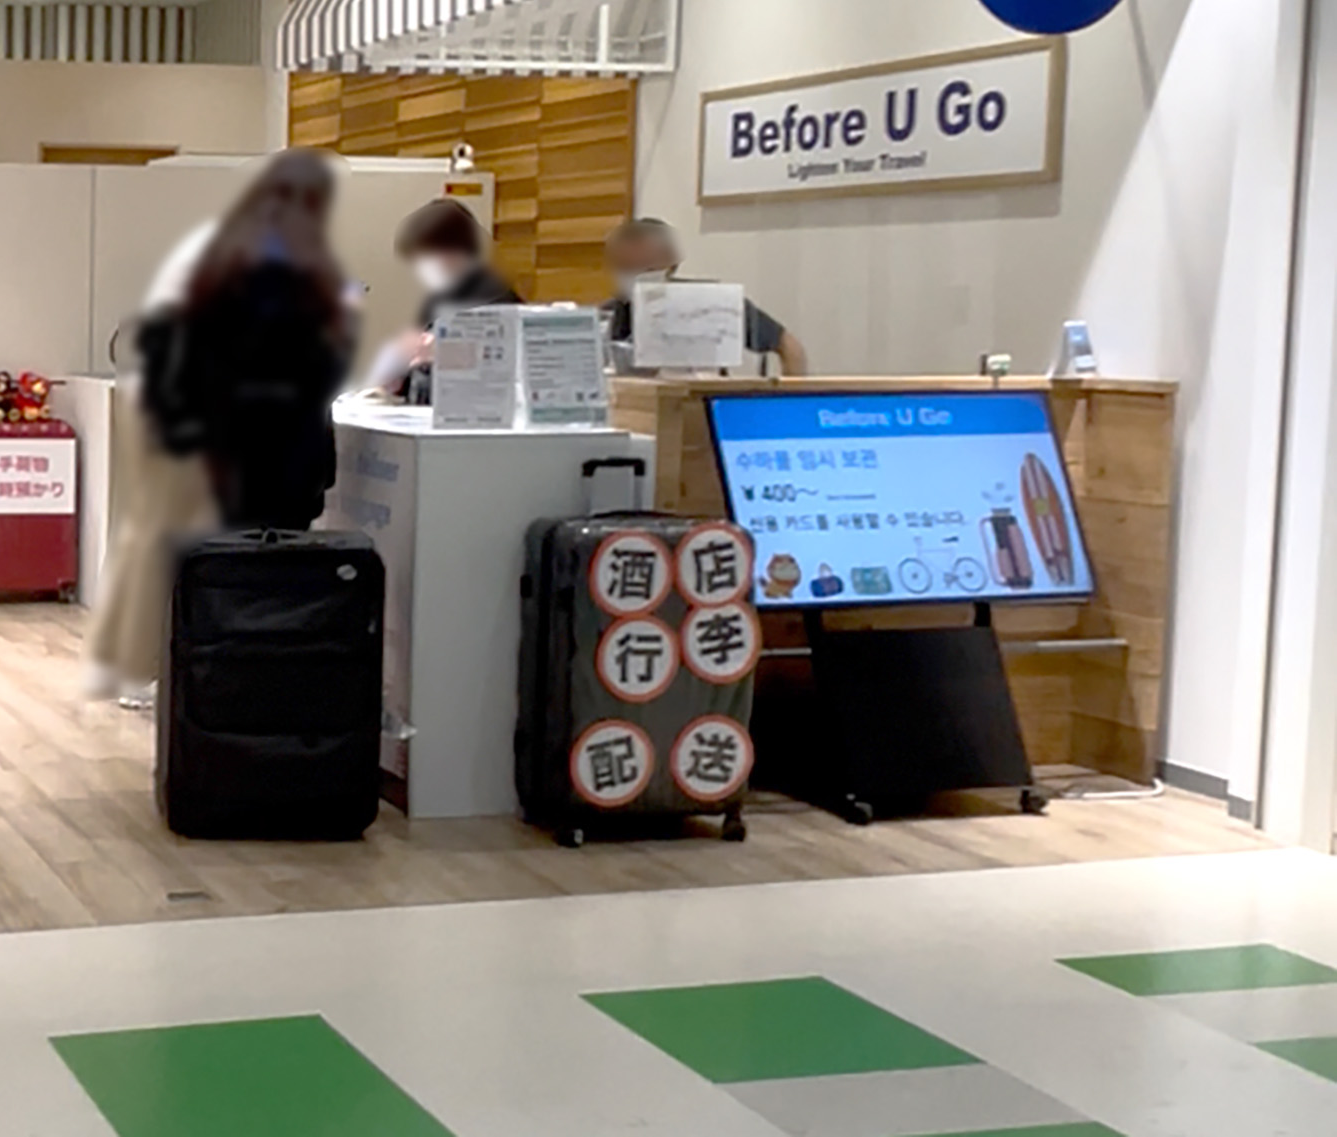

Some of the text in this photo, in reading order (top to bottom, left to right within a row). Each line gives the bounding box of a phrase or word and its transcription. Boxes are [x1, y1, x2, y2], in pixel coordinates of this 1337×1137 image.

[730, 80, 1006, 159] Before U Go
[879, 150, 928, 169] Travel
